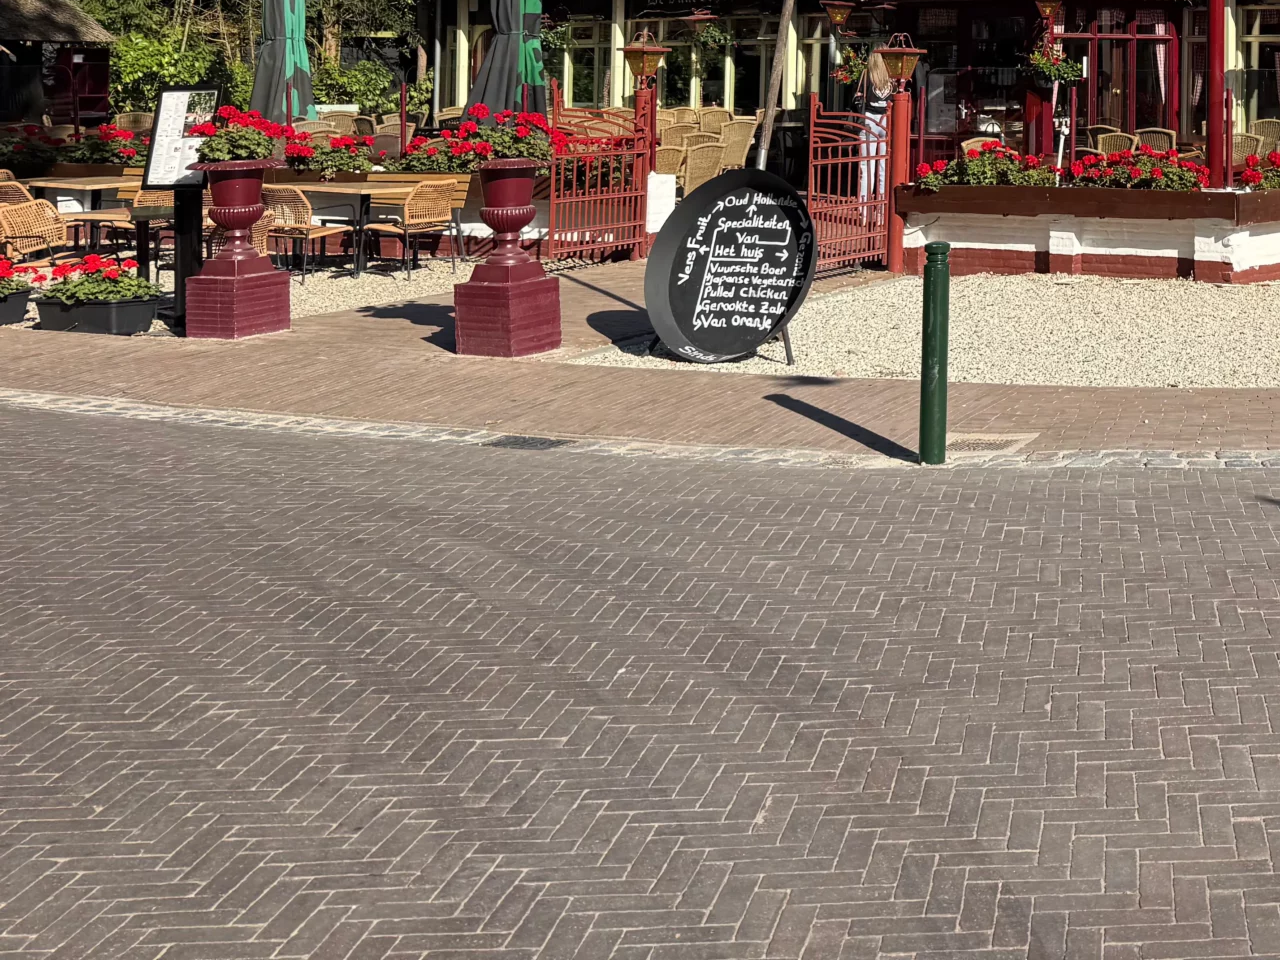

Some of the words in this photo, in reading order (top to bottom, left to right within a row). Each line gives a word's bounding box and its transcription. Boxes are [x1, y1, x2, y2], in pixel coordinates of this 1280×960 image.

[724, 192, 749, 207] Oud
[752, 192, 798, 208] Hollandse
[686, 213, 712, 249] Fruit
[718, 214, 791, 233] Specialiteiten
[735, 232, 759, 244] Van
[714, 244, 736, 257] Het
[740, 244, 764, 259] huis
[710, 262, 759, 274] Vuursche
[760, 262, 787, 275] Boer
[705, 274, 750, 286] Japanse
[703, 285, 735, 299] Pulled
[739, 286, 788, 300] Chicken
[701, 300, 756, 314] Gerookte
[700, 313, 727, 328] Van
[678, 345, 717, 361] Sinds
